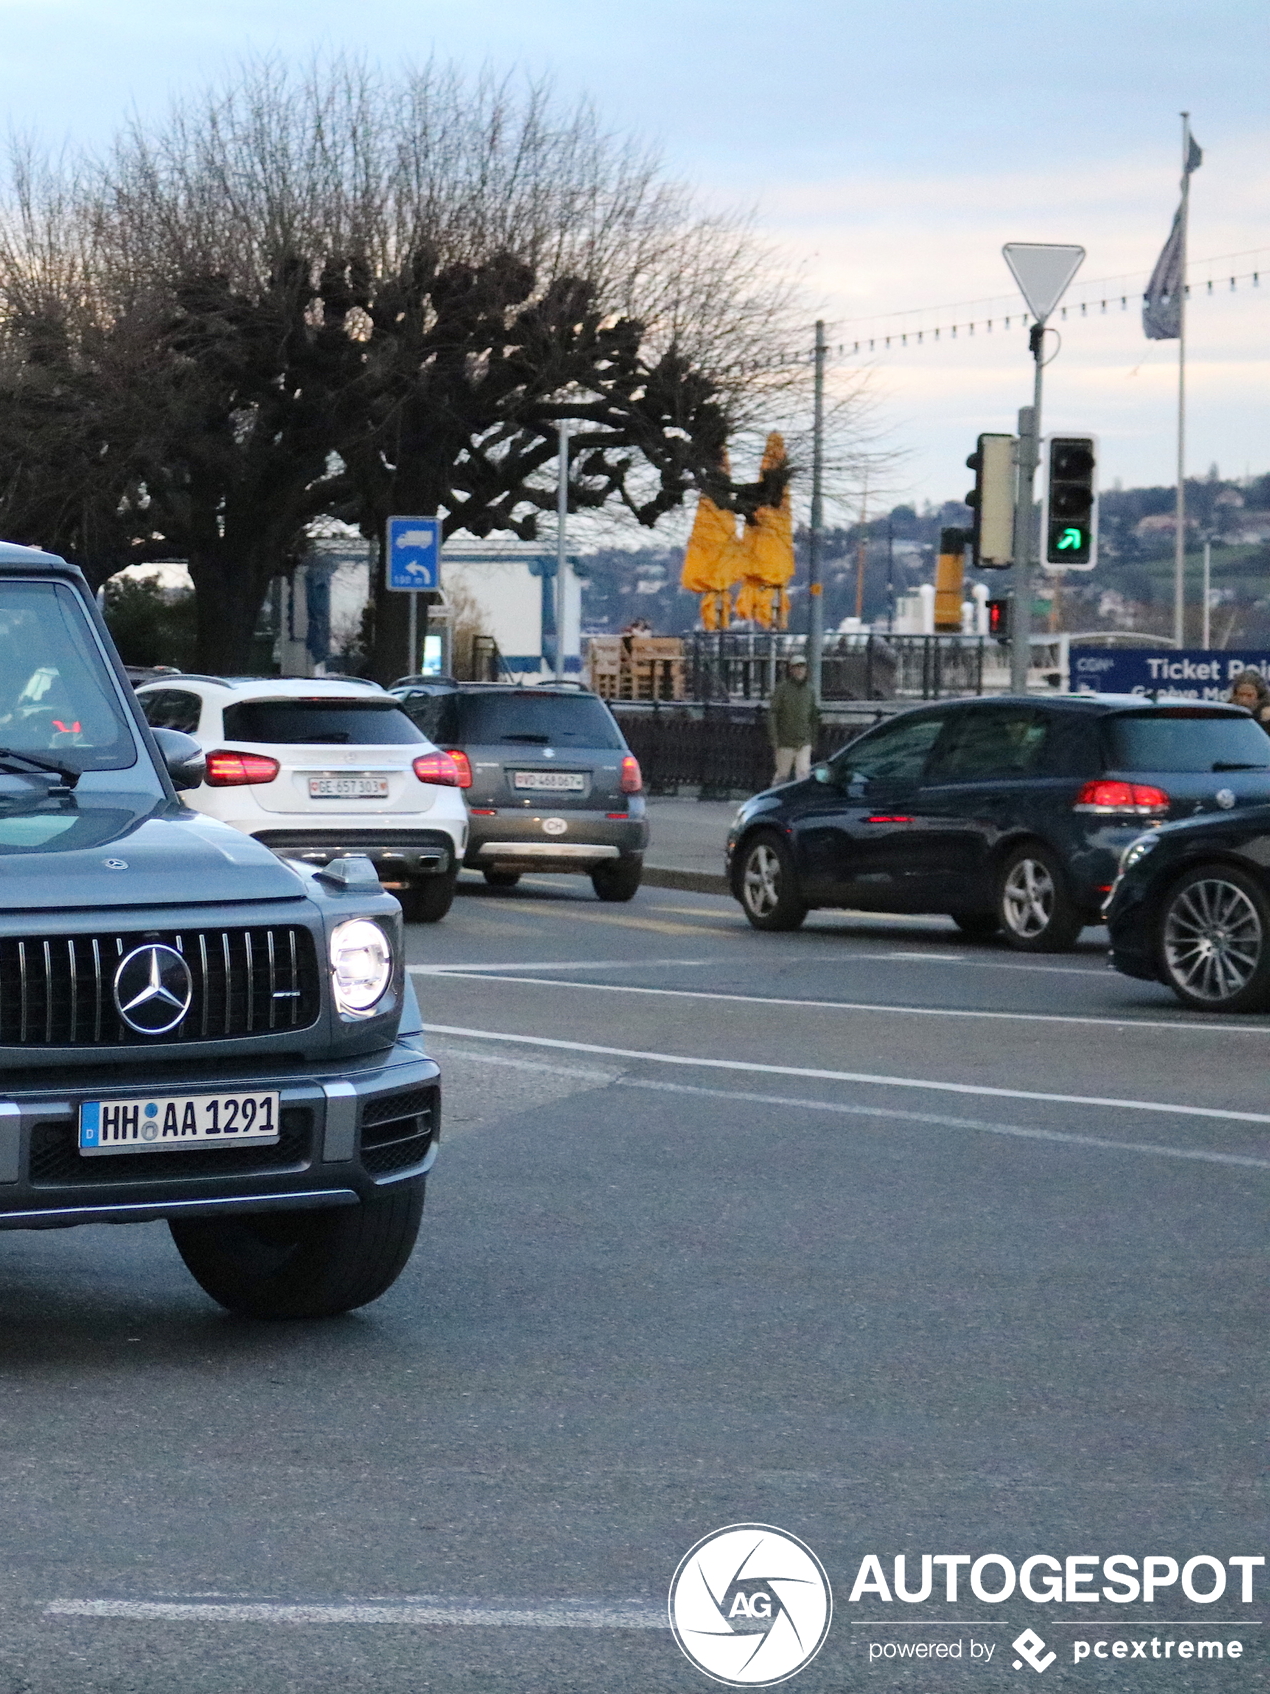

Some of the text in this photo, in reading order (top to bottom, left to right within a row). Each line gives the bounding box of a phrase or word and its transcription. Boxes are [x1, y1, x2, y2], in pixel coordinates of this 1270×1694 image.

[1146, 658, 1221, 680] Ticket
[547, 821, 563, 831] CH
[102, 1096, 275, 1141] HH AA 1291
[85, 1128, 94, 1140] D
